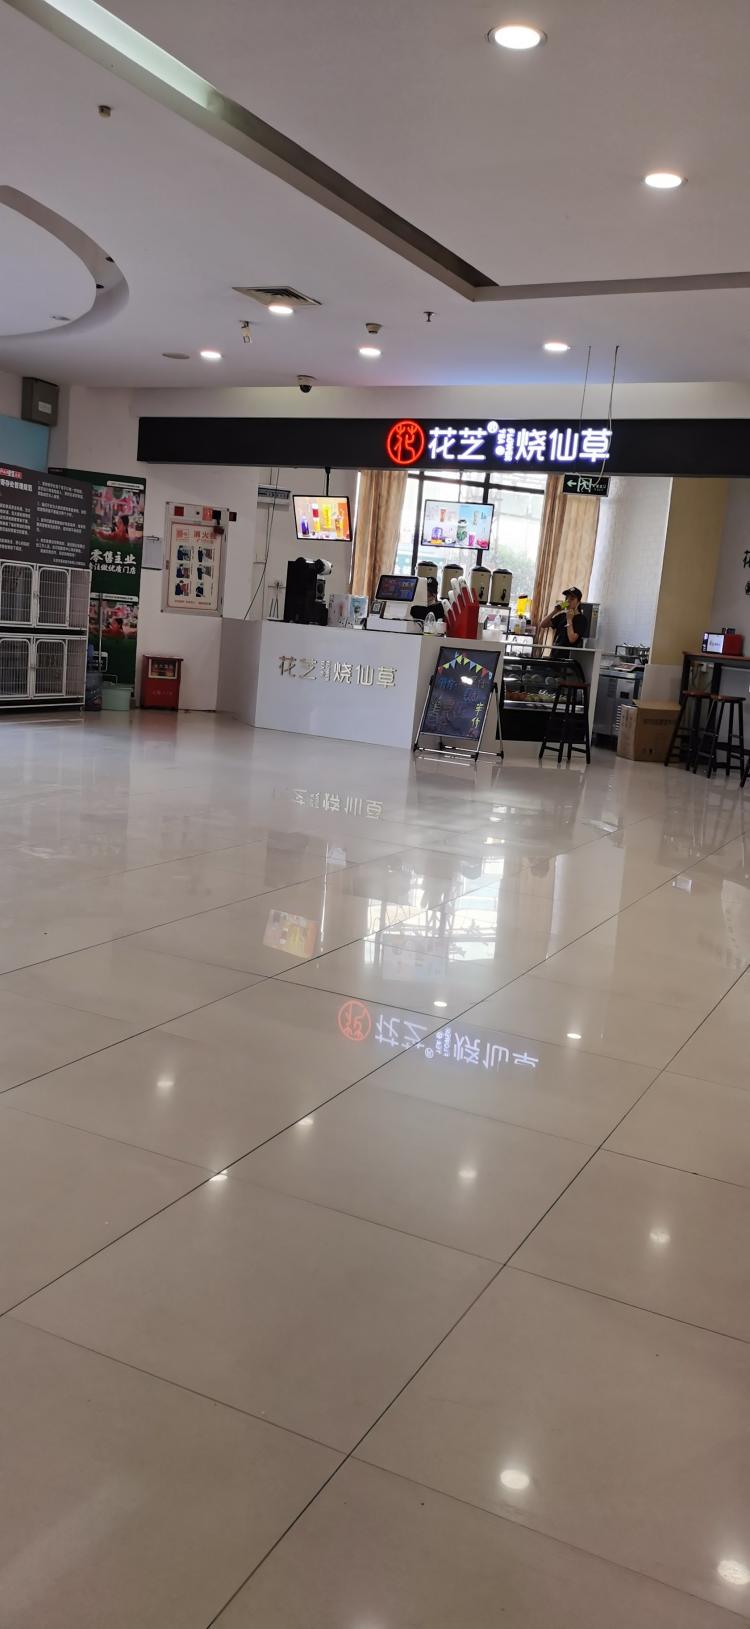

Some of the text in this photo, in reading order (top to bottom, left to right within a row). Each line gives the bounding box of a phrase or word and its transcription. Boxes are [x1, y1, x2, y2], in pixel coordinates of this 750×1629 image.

[428, 427, 611, 462] 花芝 烧仙草
[90, 549, 137, 564] 零售主业
[278, 655, 317, 681] 花芝
[333, 661, 397, 688] 烧仙草
